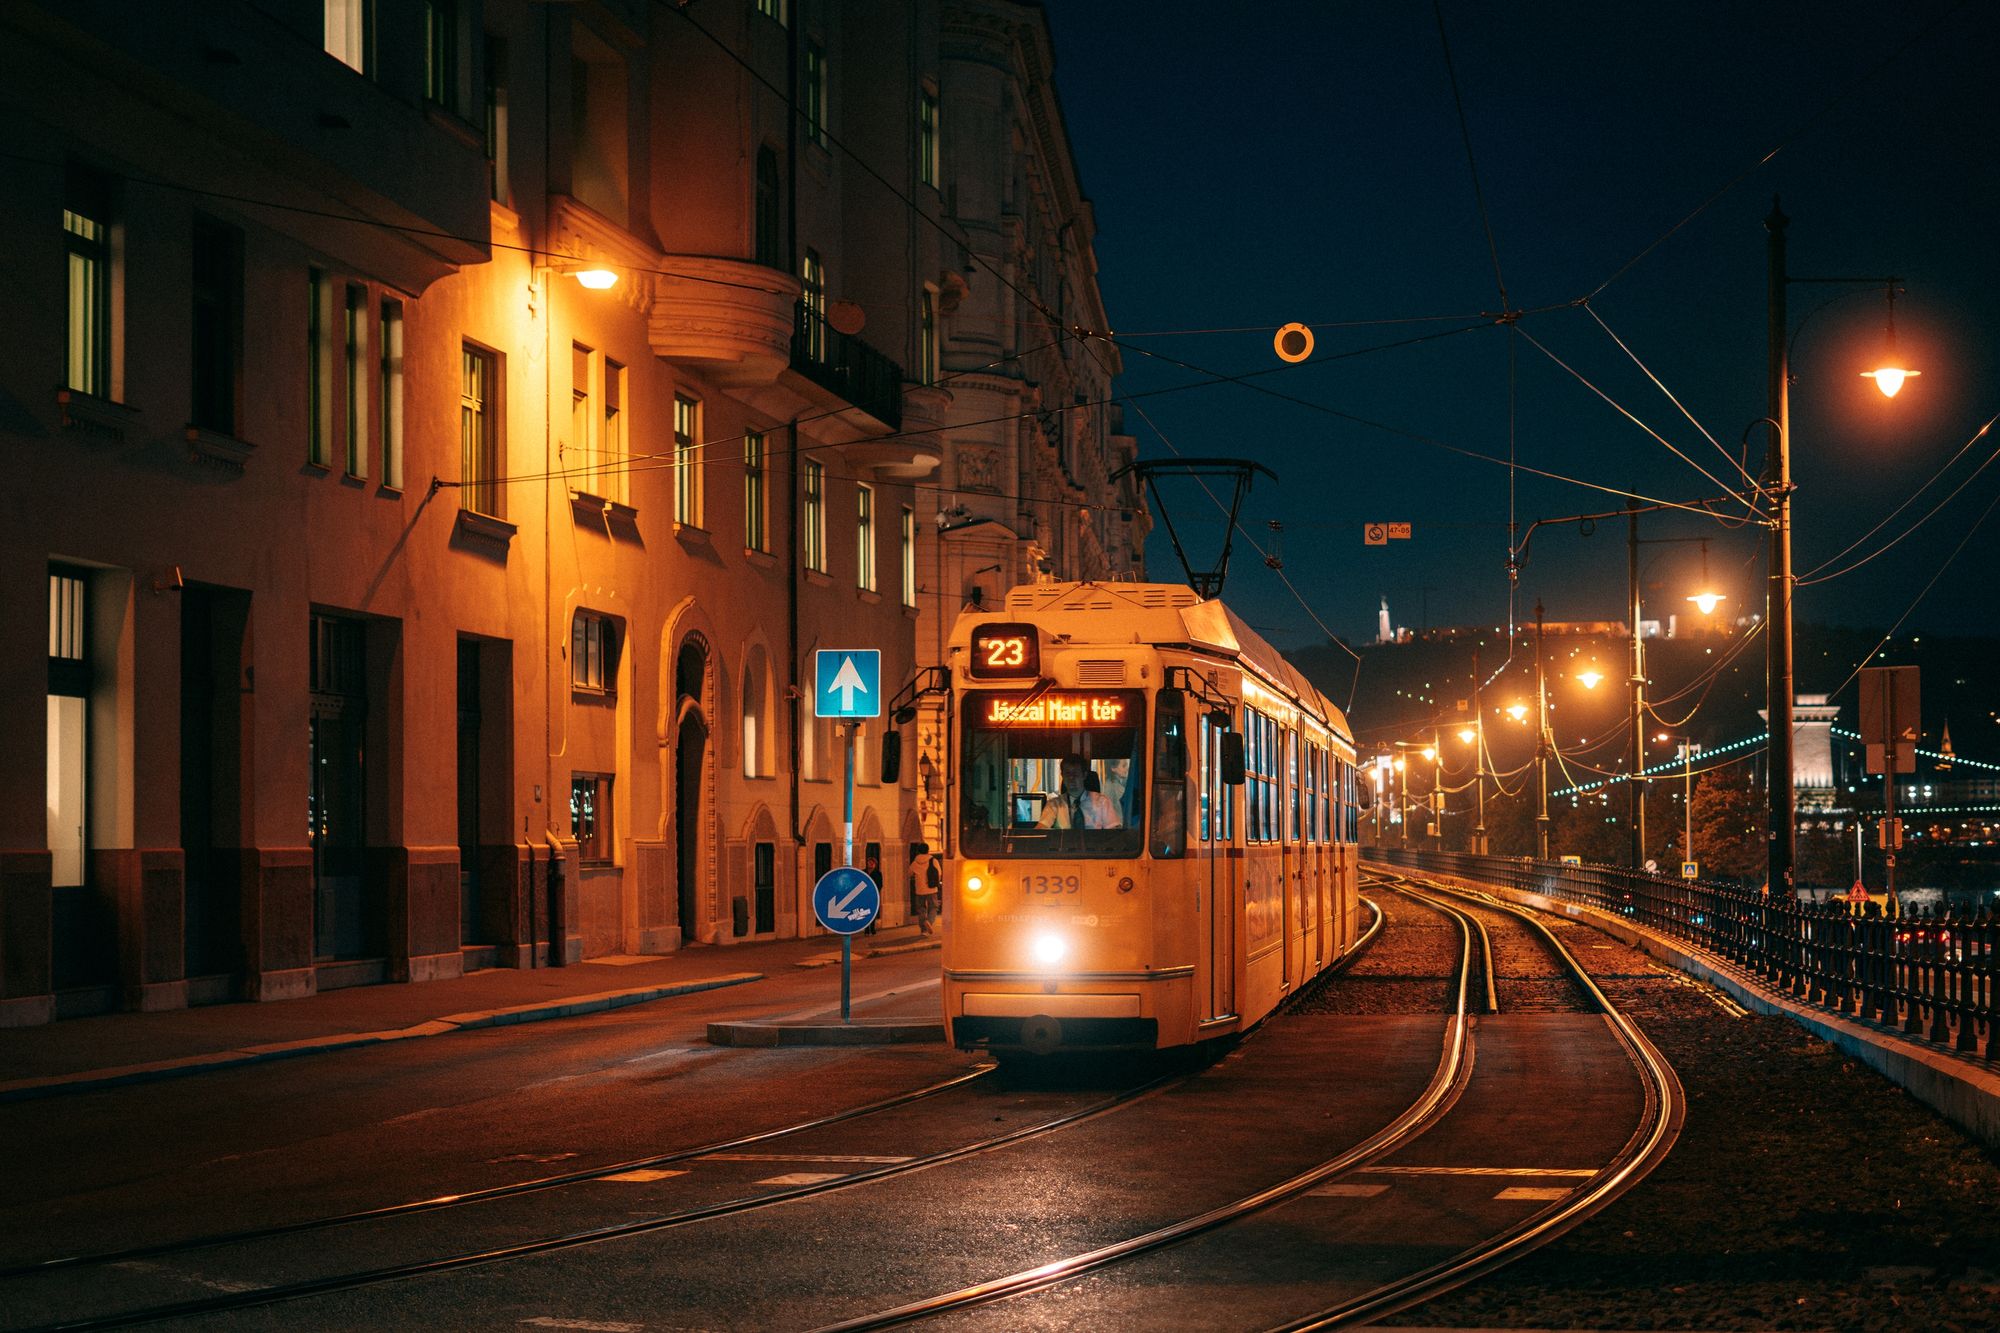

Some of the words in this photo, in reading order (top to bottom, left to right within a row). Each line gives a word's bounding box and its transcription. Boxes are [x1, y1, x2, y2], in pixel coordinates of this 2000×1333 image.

[988, 639, 1023, 665] 23
[988, 700, 1044, 721] Jászai
[1049, 700, 1087, 721] Mari
[1092, 699, 1122, 721] tér
[1022, 876, 1079, 894] 1339
